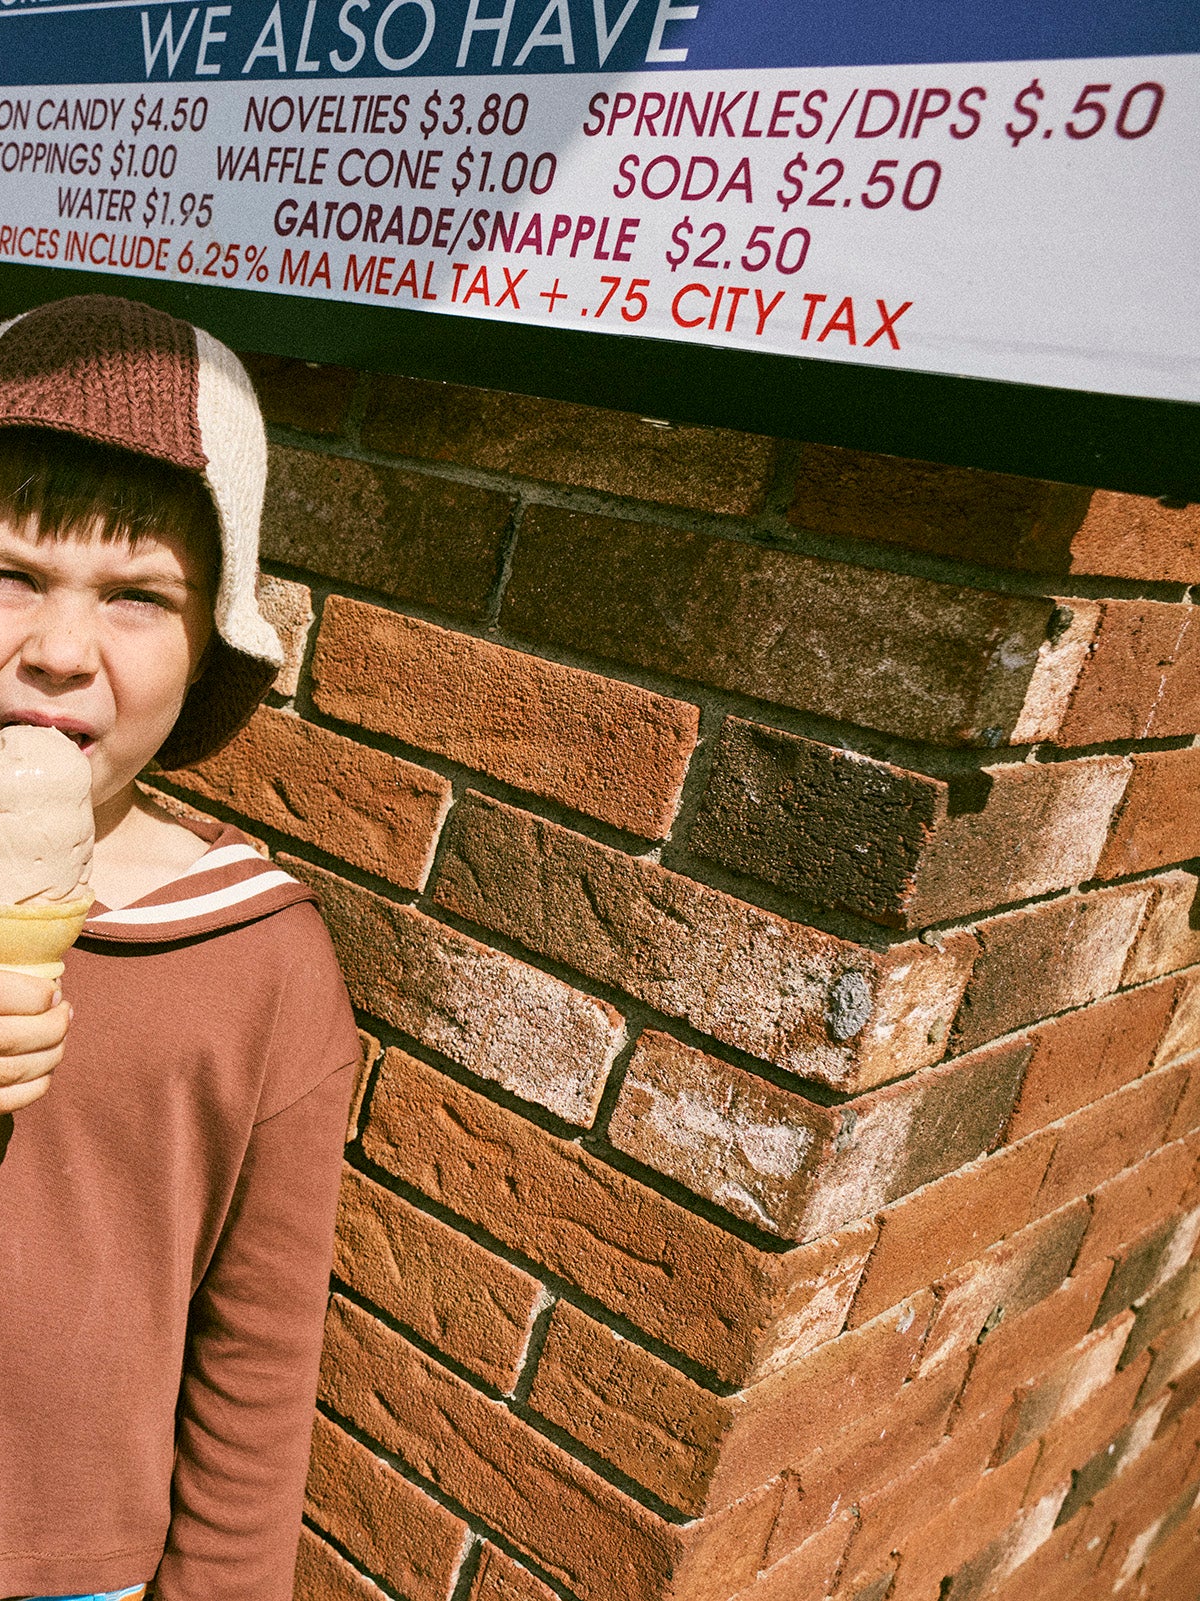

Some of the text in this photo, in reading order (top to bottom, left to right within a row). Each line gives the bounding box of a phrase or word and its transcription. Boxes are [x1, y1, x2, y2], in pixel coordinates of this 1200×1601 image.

[141, 0, 699, 78] WE ALSO HAVE
[36, 98, 125, 129] CANDY
[130, 94, 207, 134] $4.50
[243, 89, 528, 138] NOVELTIES $3.80
[1004, 78, 1165, 147] $.50
[110, 140, 177, 179] $1.00
[216, 145, 557, 195] WAFFLE CONE $1.00
[612, 152, 942, 211] SODA $2.50
[58, 186, 213, 227] WATER $1.95
[664, 215, 812, 274] $2.50
[63, 231, 170, 270] INCLUDE
[176, 240, 269, 281] 6.25%
[278, 248, 331, 288] MA
[342, 253, 438, 299] MEAL
[450, 262, 528, 309] TAX
[538, 278, 568, 312] +
[580, 276, 649, 322] .75
[671, 282, 785, 335] CITY
[800, 293, 912, 348] TAX
